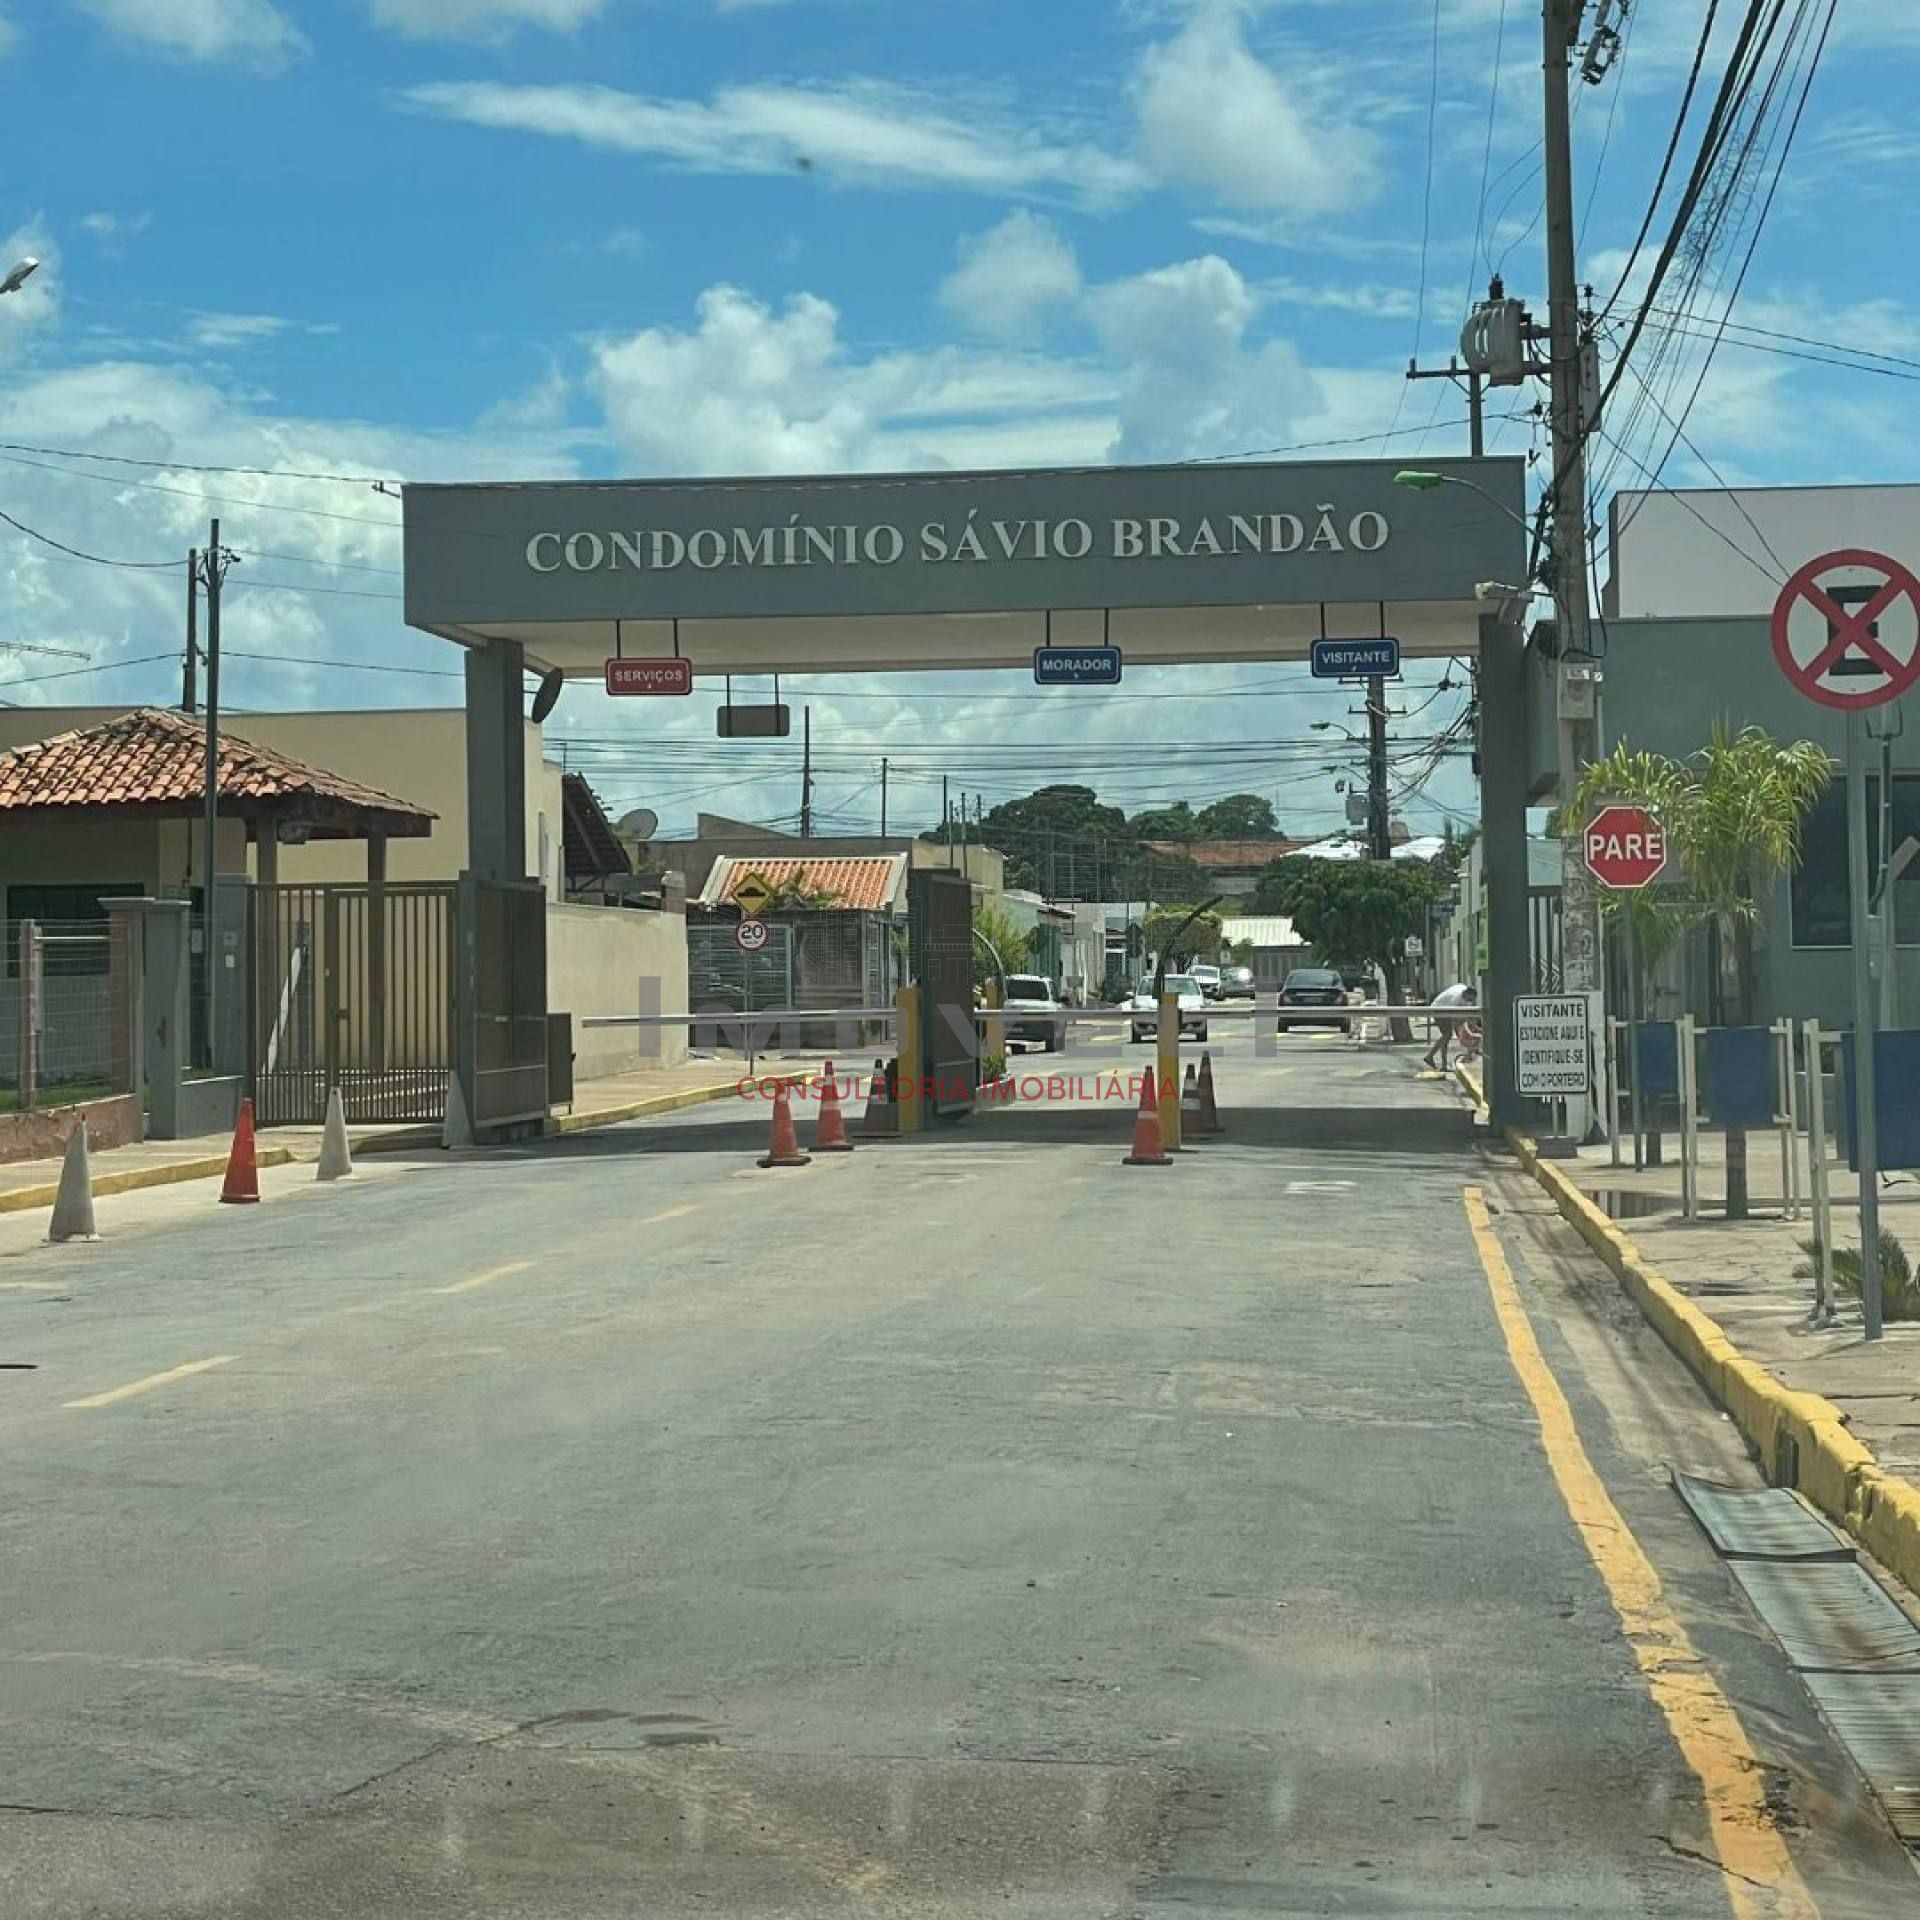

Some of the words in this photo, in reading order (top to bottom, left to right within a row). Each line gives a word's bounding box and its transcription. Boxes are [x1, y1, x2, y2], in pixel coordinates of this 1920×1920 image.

[525, 514, 904, 572] CONDOMÍNIO
[920, 509, 1093, 562] SÁVIO
[1111, 503, 1389, 556] BRANDÃO
[1322, 650, 1390, 664] VISITANTE
[1042, 659, 1112, 671] MORADOR
[614, 669, 684, 683] SERVIÇOS
[1589, 833, 1662, 861] PARE
[741, 924, 764, 940] 20
[1520, 1003, 1584, 1017] VISITANTE
[1520, 1026, 1559, 1041] ESTACIONE
